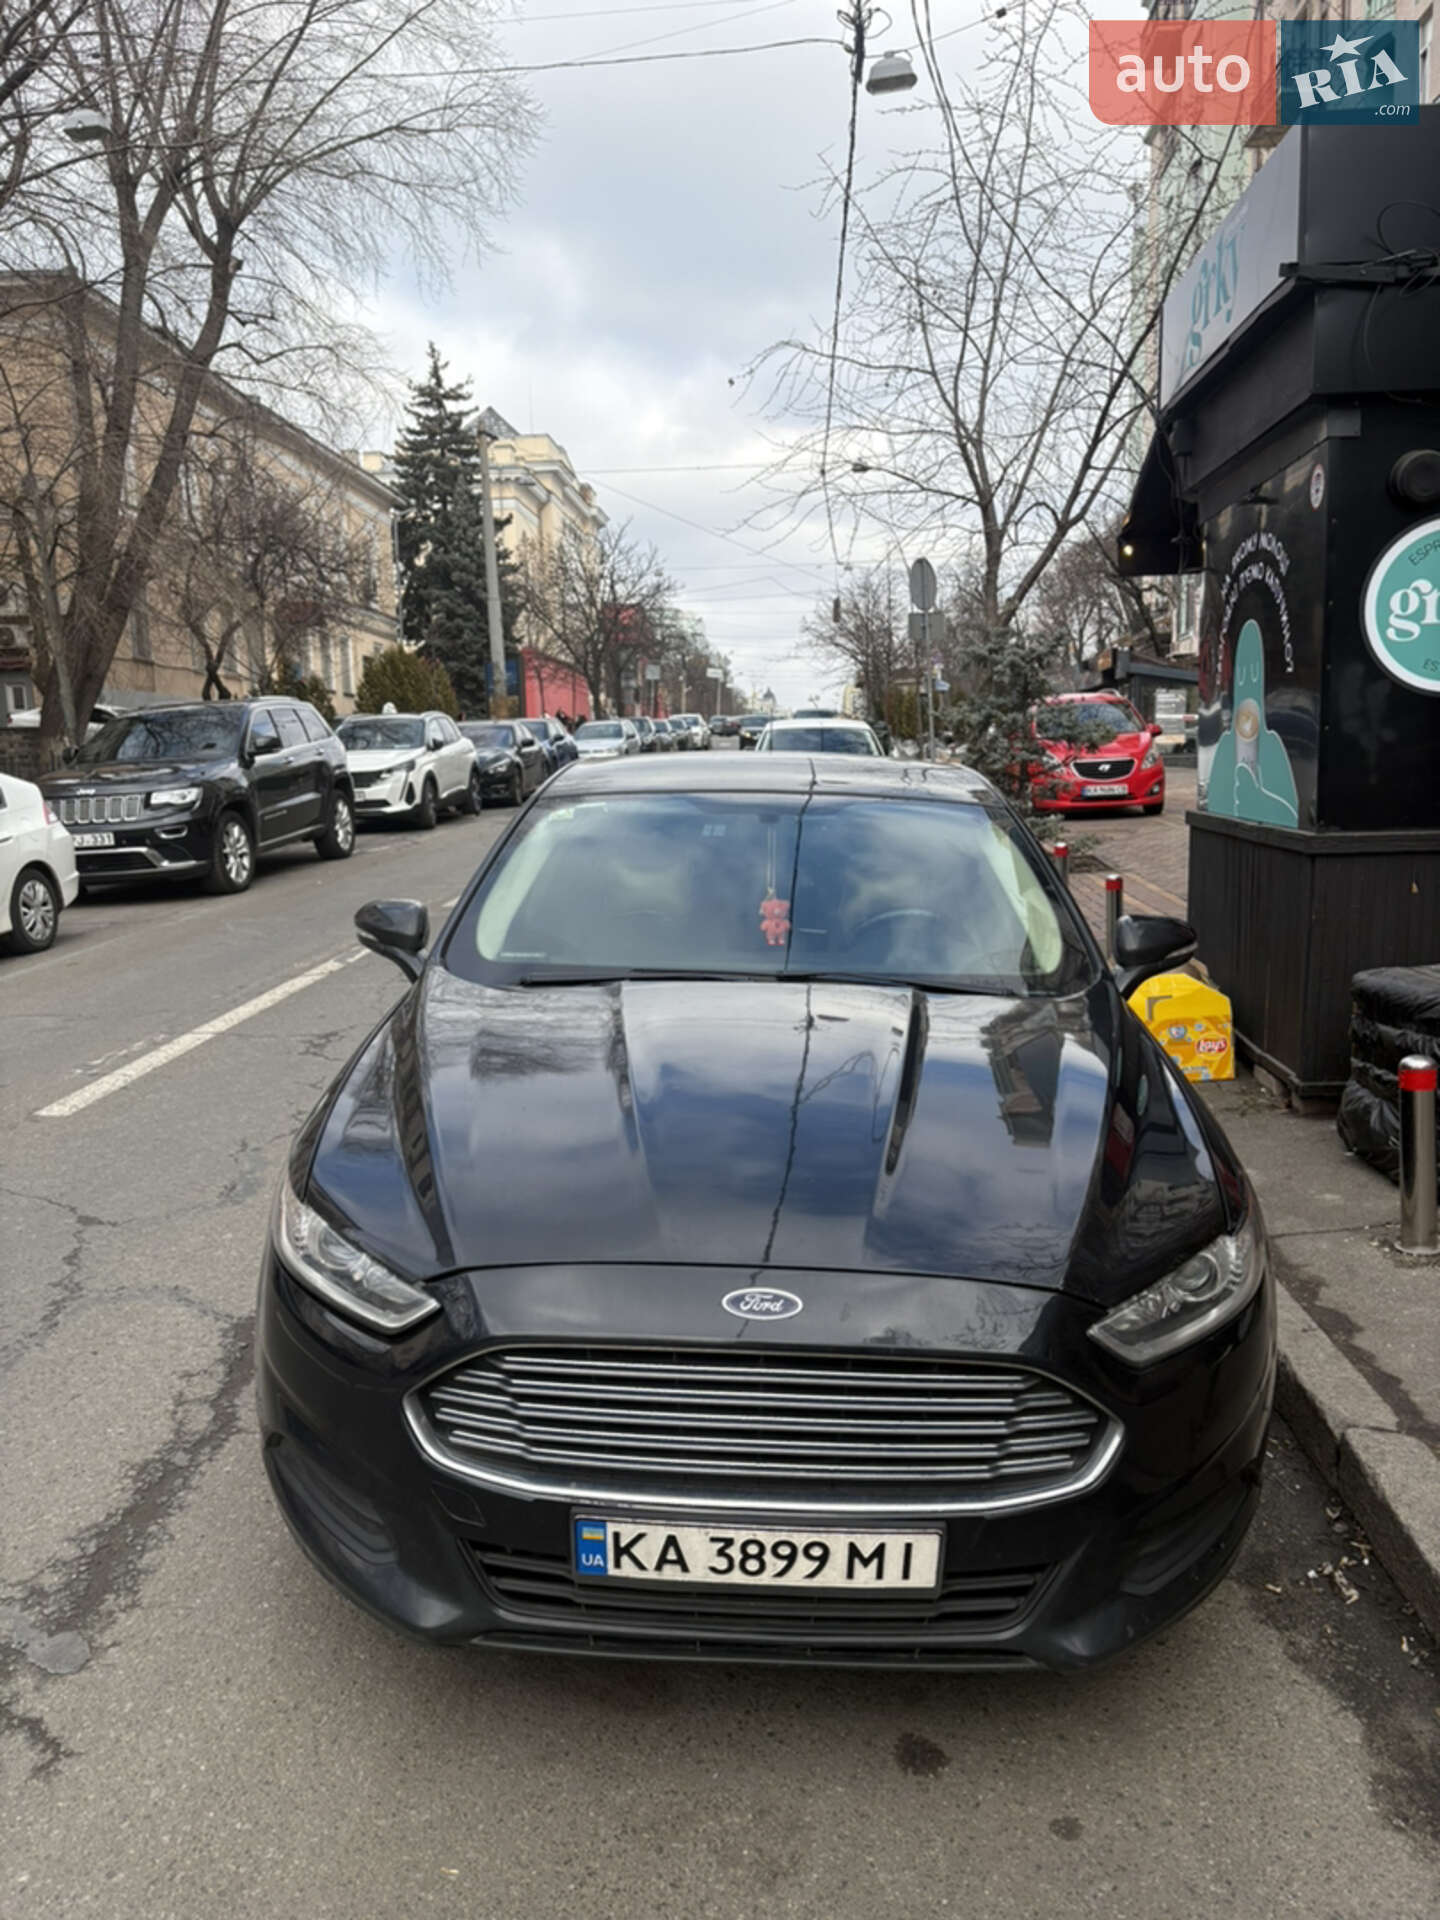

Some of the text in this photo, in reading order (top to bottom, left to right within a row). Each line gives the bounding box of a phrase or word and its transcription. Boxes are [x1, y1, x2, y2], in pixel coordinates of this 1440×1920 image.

[740, 1293, 784, 1312] Ford
[581, 1553, 605, 1567] UA
[612, 1531, 914, 1581] KA 3899 MI
